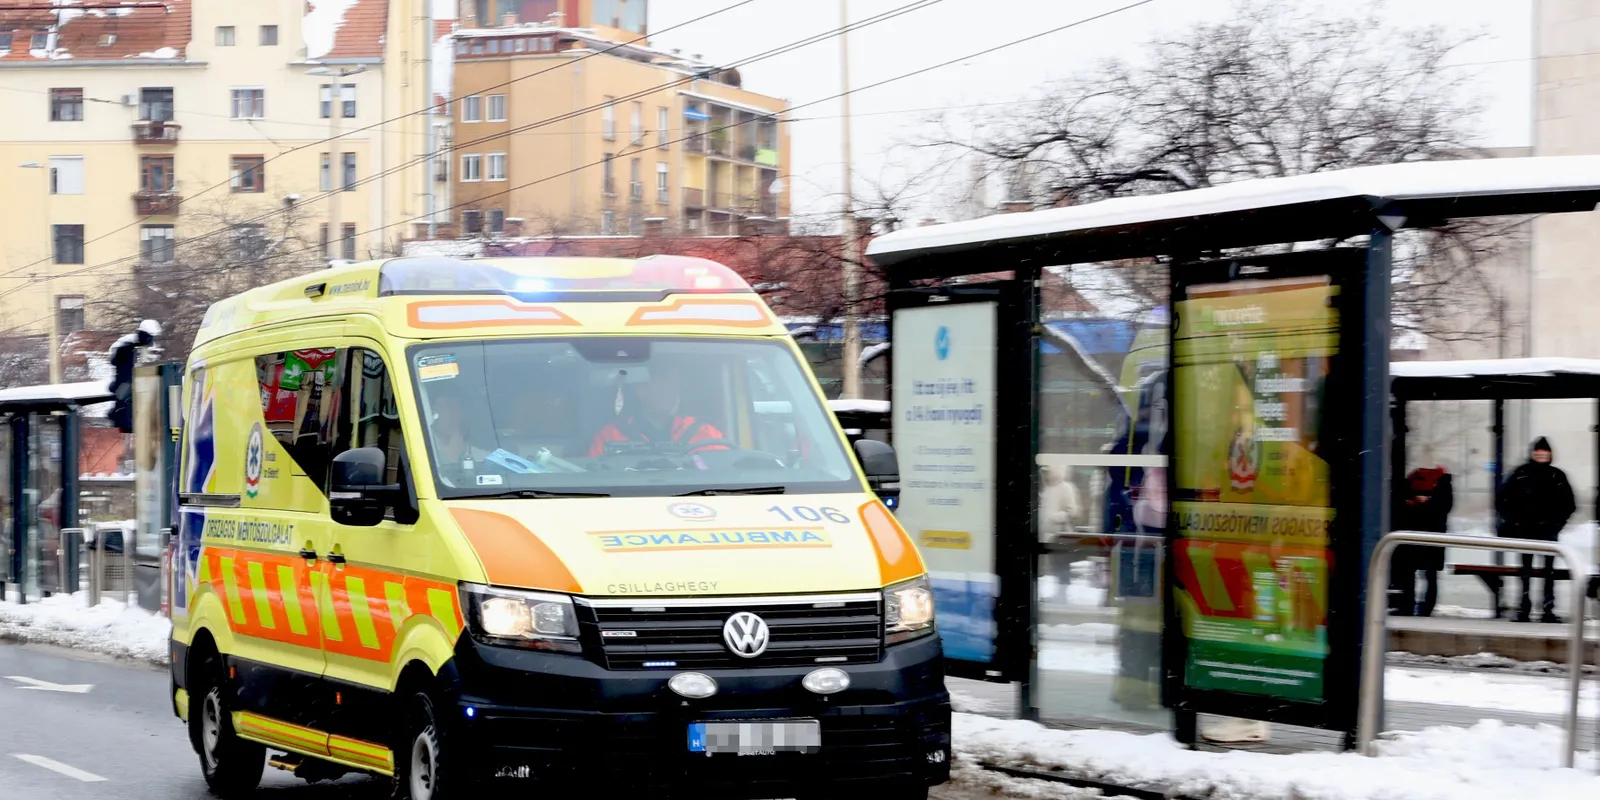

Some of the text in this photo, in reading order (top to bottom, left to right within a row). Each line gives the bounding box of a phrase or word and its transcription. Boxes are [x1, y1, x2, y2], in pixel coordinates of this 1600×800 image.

[767, 505, 850, 524] 106
[206, 516, 294, 544] ORSZÁGOS MENTŐSZOLGÁLAT
[607, 581, 719, 594] CSILLAGHEGY
[692, 739, 700, 748] H
